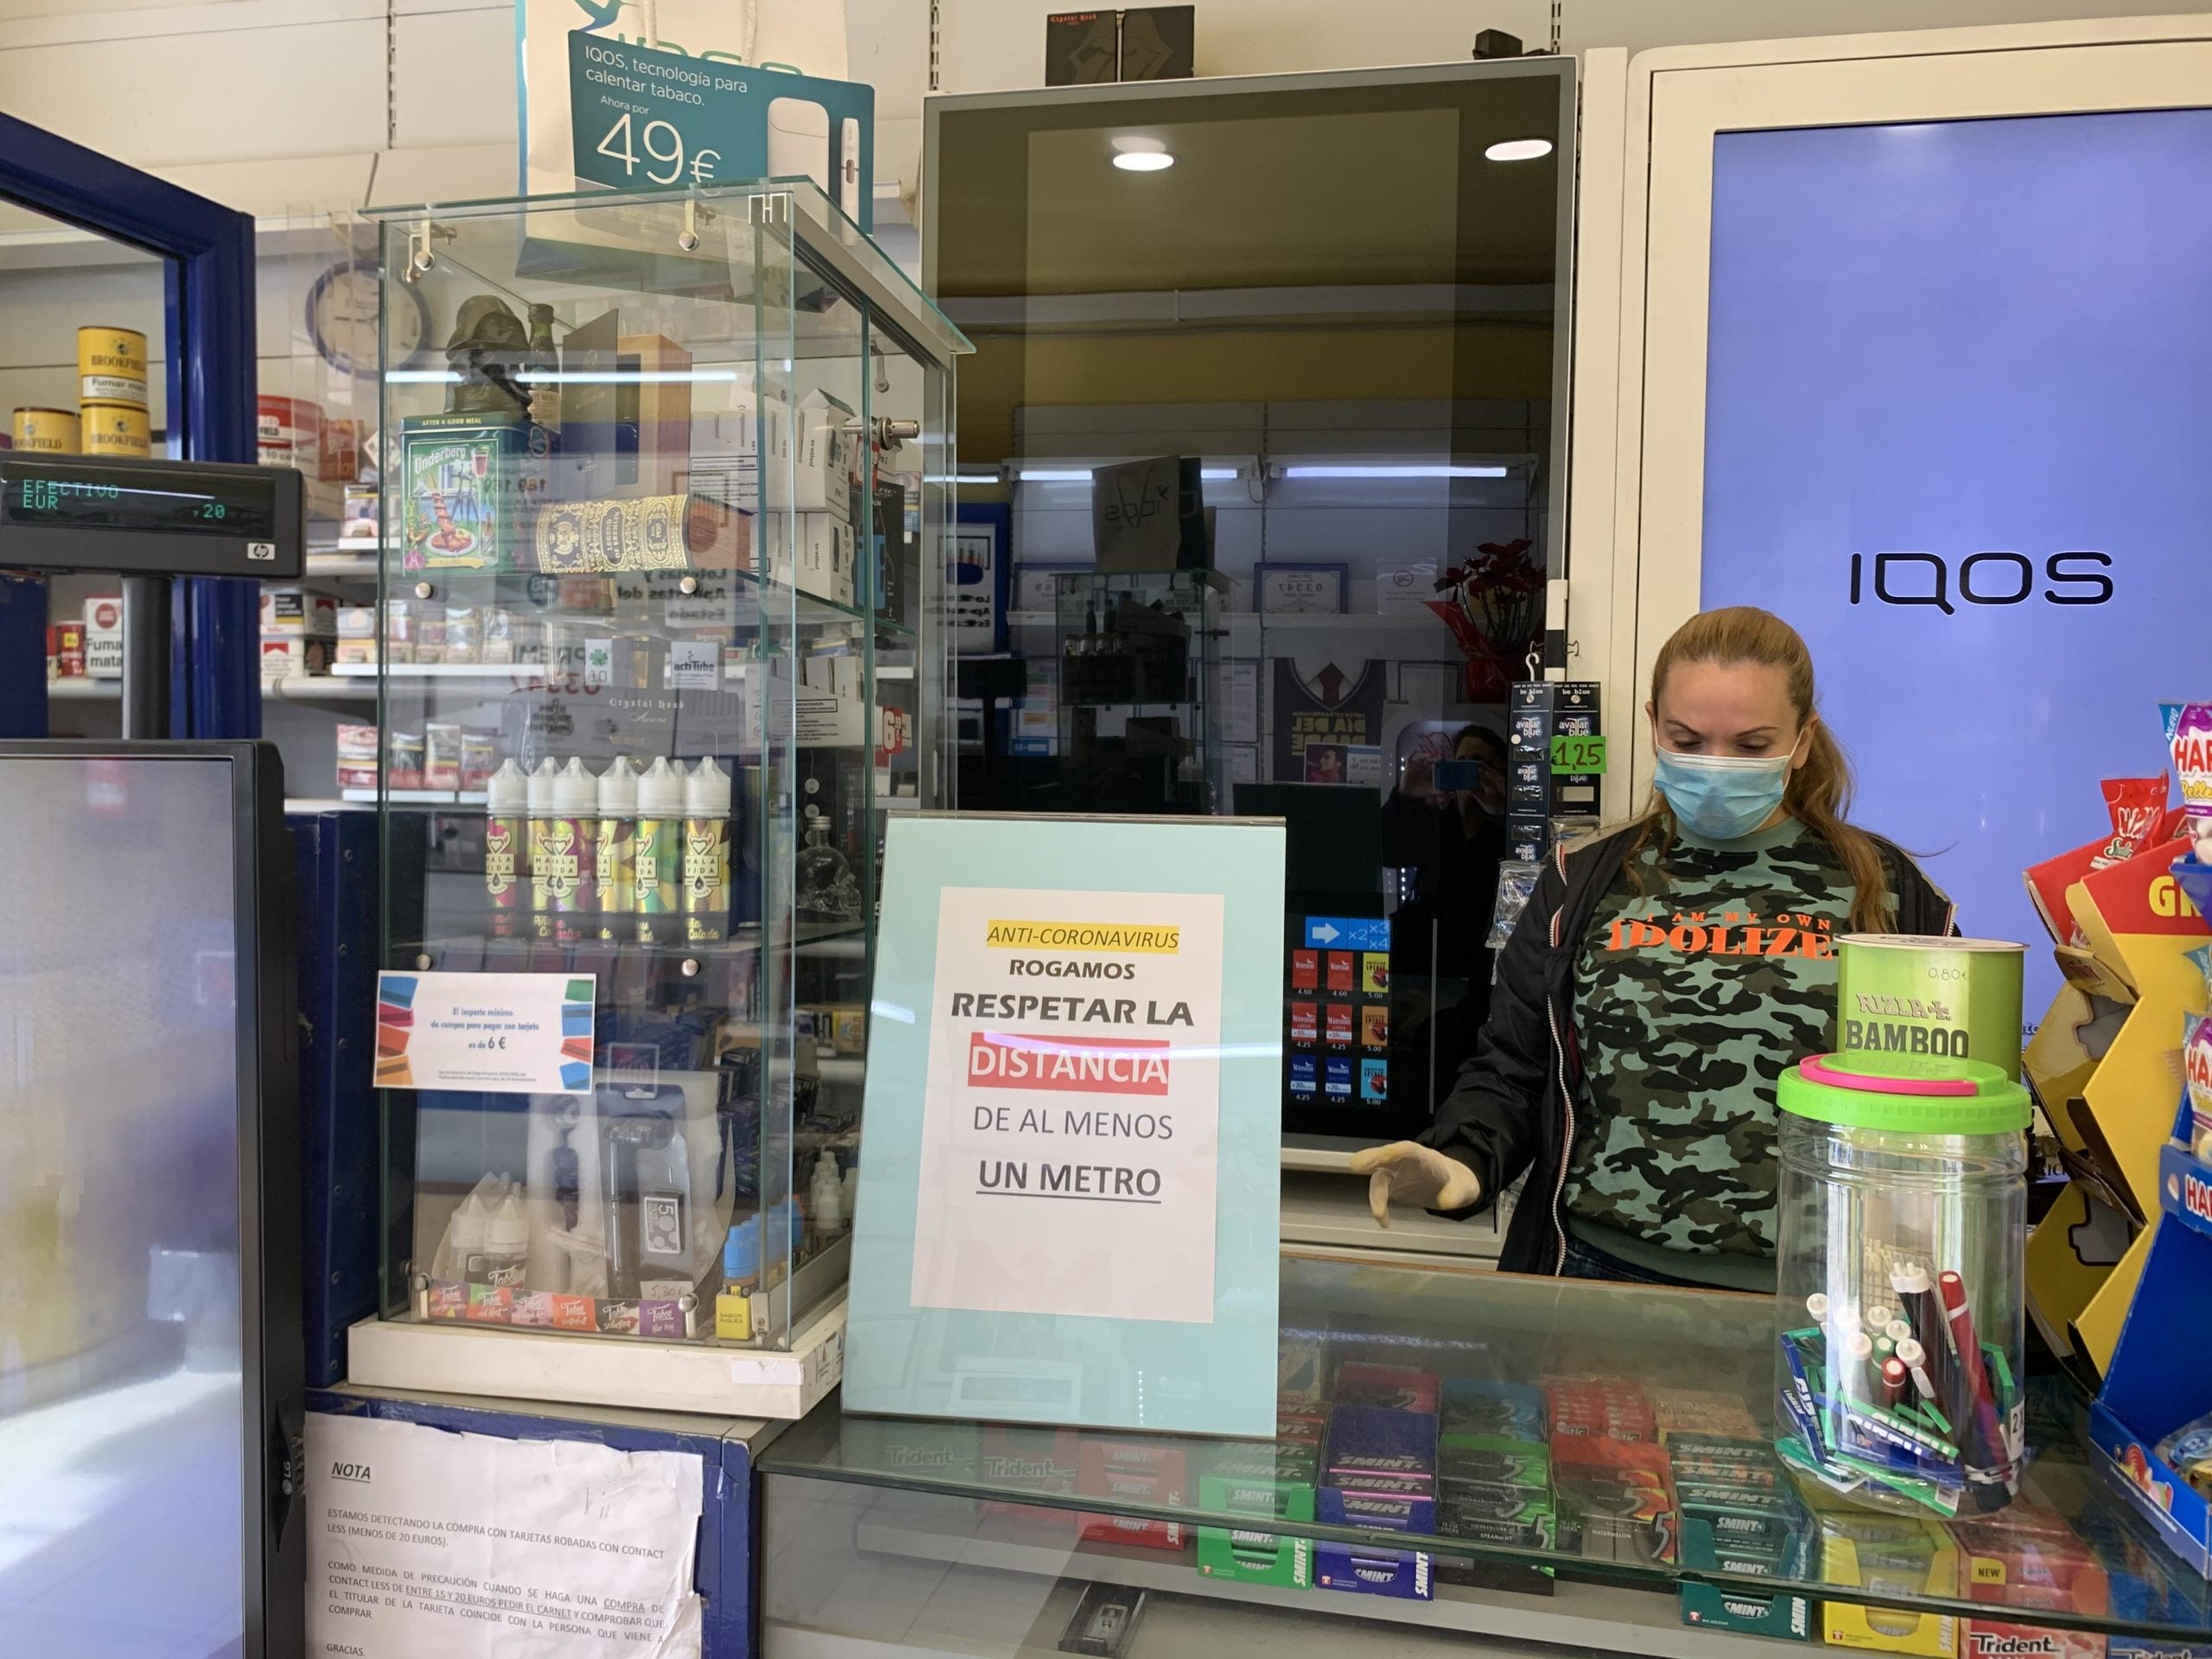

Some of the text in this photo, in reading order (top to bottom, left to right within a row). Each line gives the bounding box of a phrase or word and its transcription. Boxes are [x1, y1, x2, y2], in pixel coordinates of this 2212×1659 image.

[585, 46, 629, 72] IQOS,
[633, 58, 711, 87] tecnología
[715, 77, 747, 93] para
[587, 68, 705, 105] calentar tabaco.
[601, 96, 649, 116] Ahora por
[414, 446, 467, 474] Underberg
[23, 480, 119, 499] EFECTIVO
[23, 494, 58, 510] EUR
[1850, 551, 2114, 615] IQOS
[1647, 912, 1832, 931] I AM MY OWN
[987, 925, 1179, 950] ANTI-CORONAVIRUS
[1008, 959, 1135, 980] ROGAMOS
[461, 1007, 486, 1019] importe
[950, 992, 1195, 1027] RESPETAR LA
[442, 1023, 465, 1032] compra
[467, 1023, 482, 1032] para
[484, 1023, 502, 1032] pagar
[518, 1023, 539, 1033] tarjeta
[1846, 1020, 1969, 1058] BAMBOO
[488, 1037, 495, 1049] 6
[499, 1037, 506, 1049] €
[970, 1045, 1168, 1084] DISTANCIA
[975, 1106, 1173, 1141] DE AL MENOS
[978, 1160, 1162, 1197] UN METRO
[647, 1304, 674, 1322] Taboo
[885, 1445, 954, 1466] Trident
[983, 1455, 1055, 1478] Trident
[332, 1462, 371, 1483] NOTA
[328, 1509, 664, 1559] ESTAMOS DETECTANDO LA COMPRA CON TARJETAS ROBADAS CON CONTACT
[1650, 1511, 1671, 1558] 5
[1716, 1516, 1764, 1532] SMINT
[327, 1524, 448, 1548] LESS (MENOS DE 20 EUROS).
[1978, 1567, 2000, 1578] NEW
[328, 1561, 664, 1613] COMO MEDIDA DE PRECAUCIÓN CUANDO SE HAGA UNA COMPRA DE
[328, 1605, 373, 1619] COMPRAR.
[329, 1576, 369, 1587] CONTACT
[372, 1580, 391, 1591] LESS
[393, 1583, 403, 1592] DE
[406, 1586, 433, 1598] ENTRE
[435, 1589, 446, 1599] 15
[448, 1591, 454, 1599] Y
[454, 1592, 466, 1601] 20
[467, 1594, 497, 1606] EUROS
[499, 1599, 524, 1611] PEDIR
[525, 1603, 535, 1612] EL
[537, 1605, 572, 1619] CARNET
[582, 1612, 642, 1626] COMPROBAR
[645, 1618, 664, 1628] QUE
[329, 1589, 339, 1599] EL
[345, 1591, 379, 1604] TITULAR
[385, 1598, 397, 1606] DE
[403, 1599, 413, 1609] LA
[419, 1602, 454, 1616] TARJETA
[460, 1607, 502, 1622] COINCIDE
[508, 1616, 526, 1626] CON
[532, 1620, 543, 1629] LA
[550, 1622, 591, 1635] PERSONA
[597, 1629, 618, 1639] QUE
[624, 1631, 652, 1642] VIENE
[327, 1643, 365, 1657] GRACIAS.
[1970, 1634, 2062, 1653] Trident
